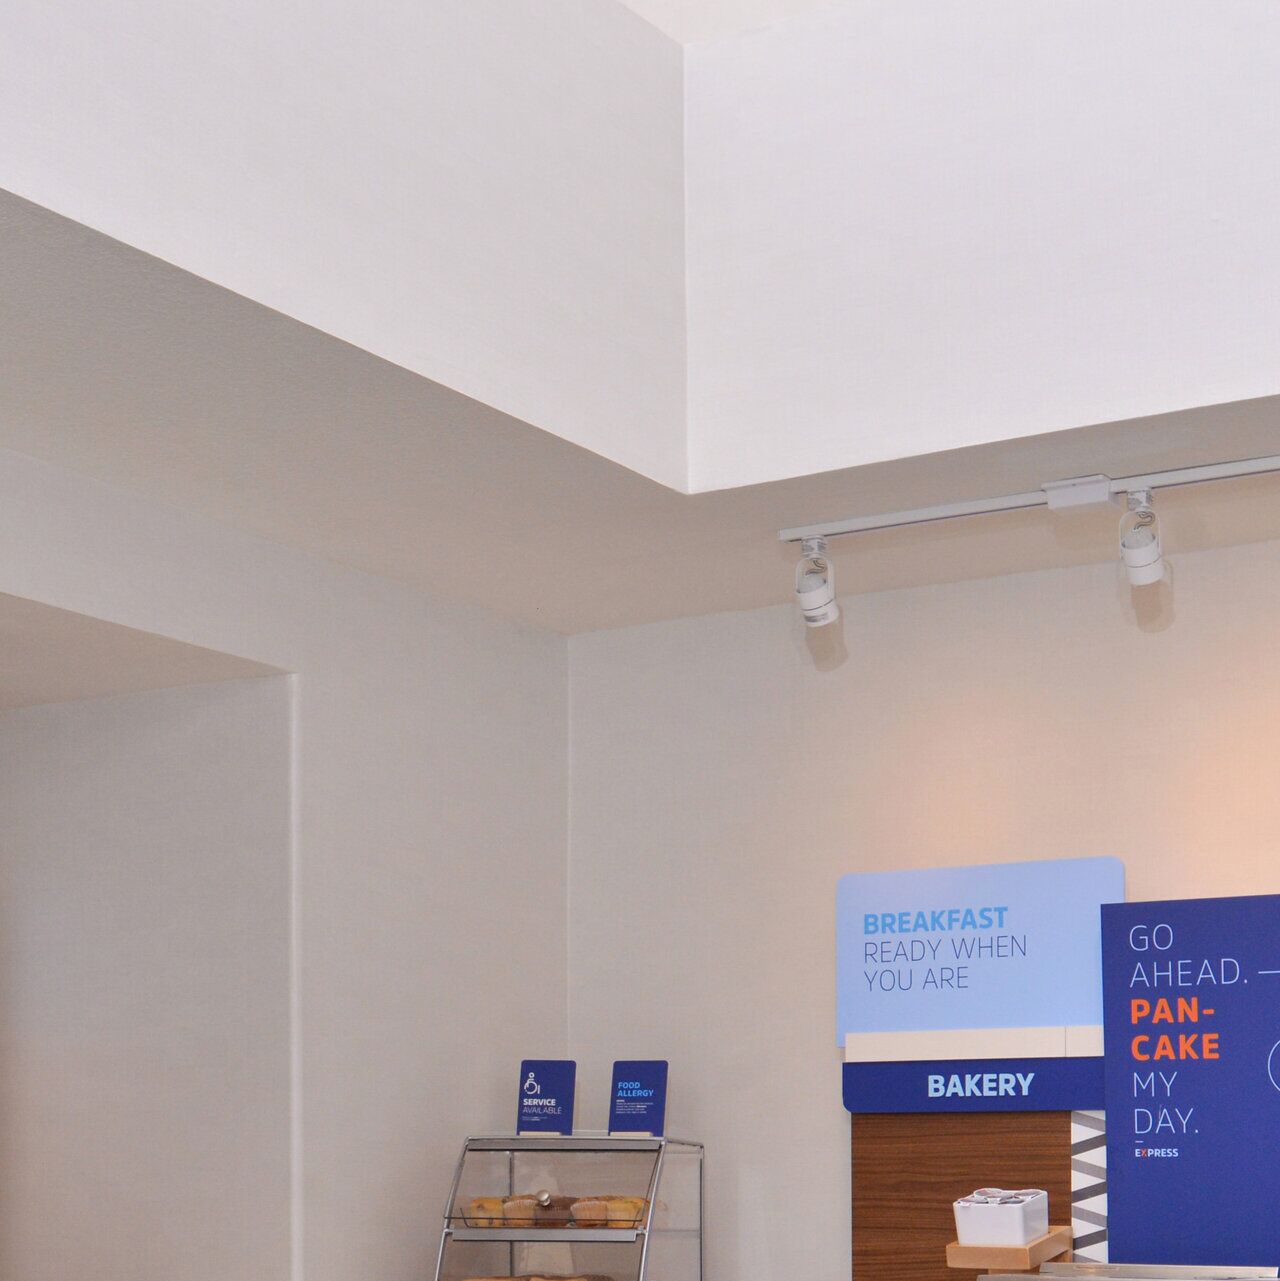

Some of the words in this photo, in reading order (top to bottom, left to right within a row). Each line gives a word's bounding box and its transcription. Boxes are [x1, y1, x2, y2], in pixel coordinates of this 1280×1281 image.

[863, 906, 1008, 935] BREAKFAST
[864, 938, 942, 964] READY
[951, 934, 1027, 960] WHEN
[1129, 923, 1174, 952] GO
[863, 969, 913, 992] YOU
[922, 966, 969, 990] ARE
[1129, 958, 1249, 988] AHEAD.
[1130, 996, 1216, 1025] PAN-
[1131, 1033, 1220, 1061] CAKE
[927, 1073, 1035, 1098] BAKERY
[1133, 1071, 1178, 1098] MY
[522, 1098, 556, 1106] SERVICE
[522, 1106, 563, 1115] AVAILABLE
[1134, 1107, 1199, 1135] DAY.
[1135, 1148, 1179, 1158] EXPRESS
